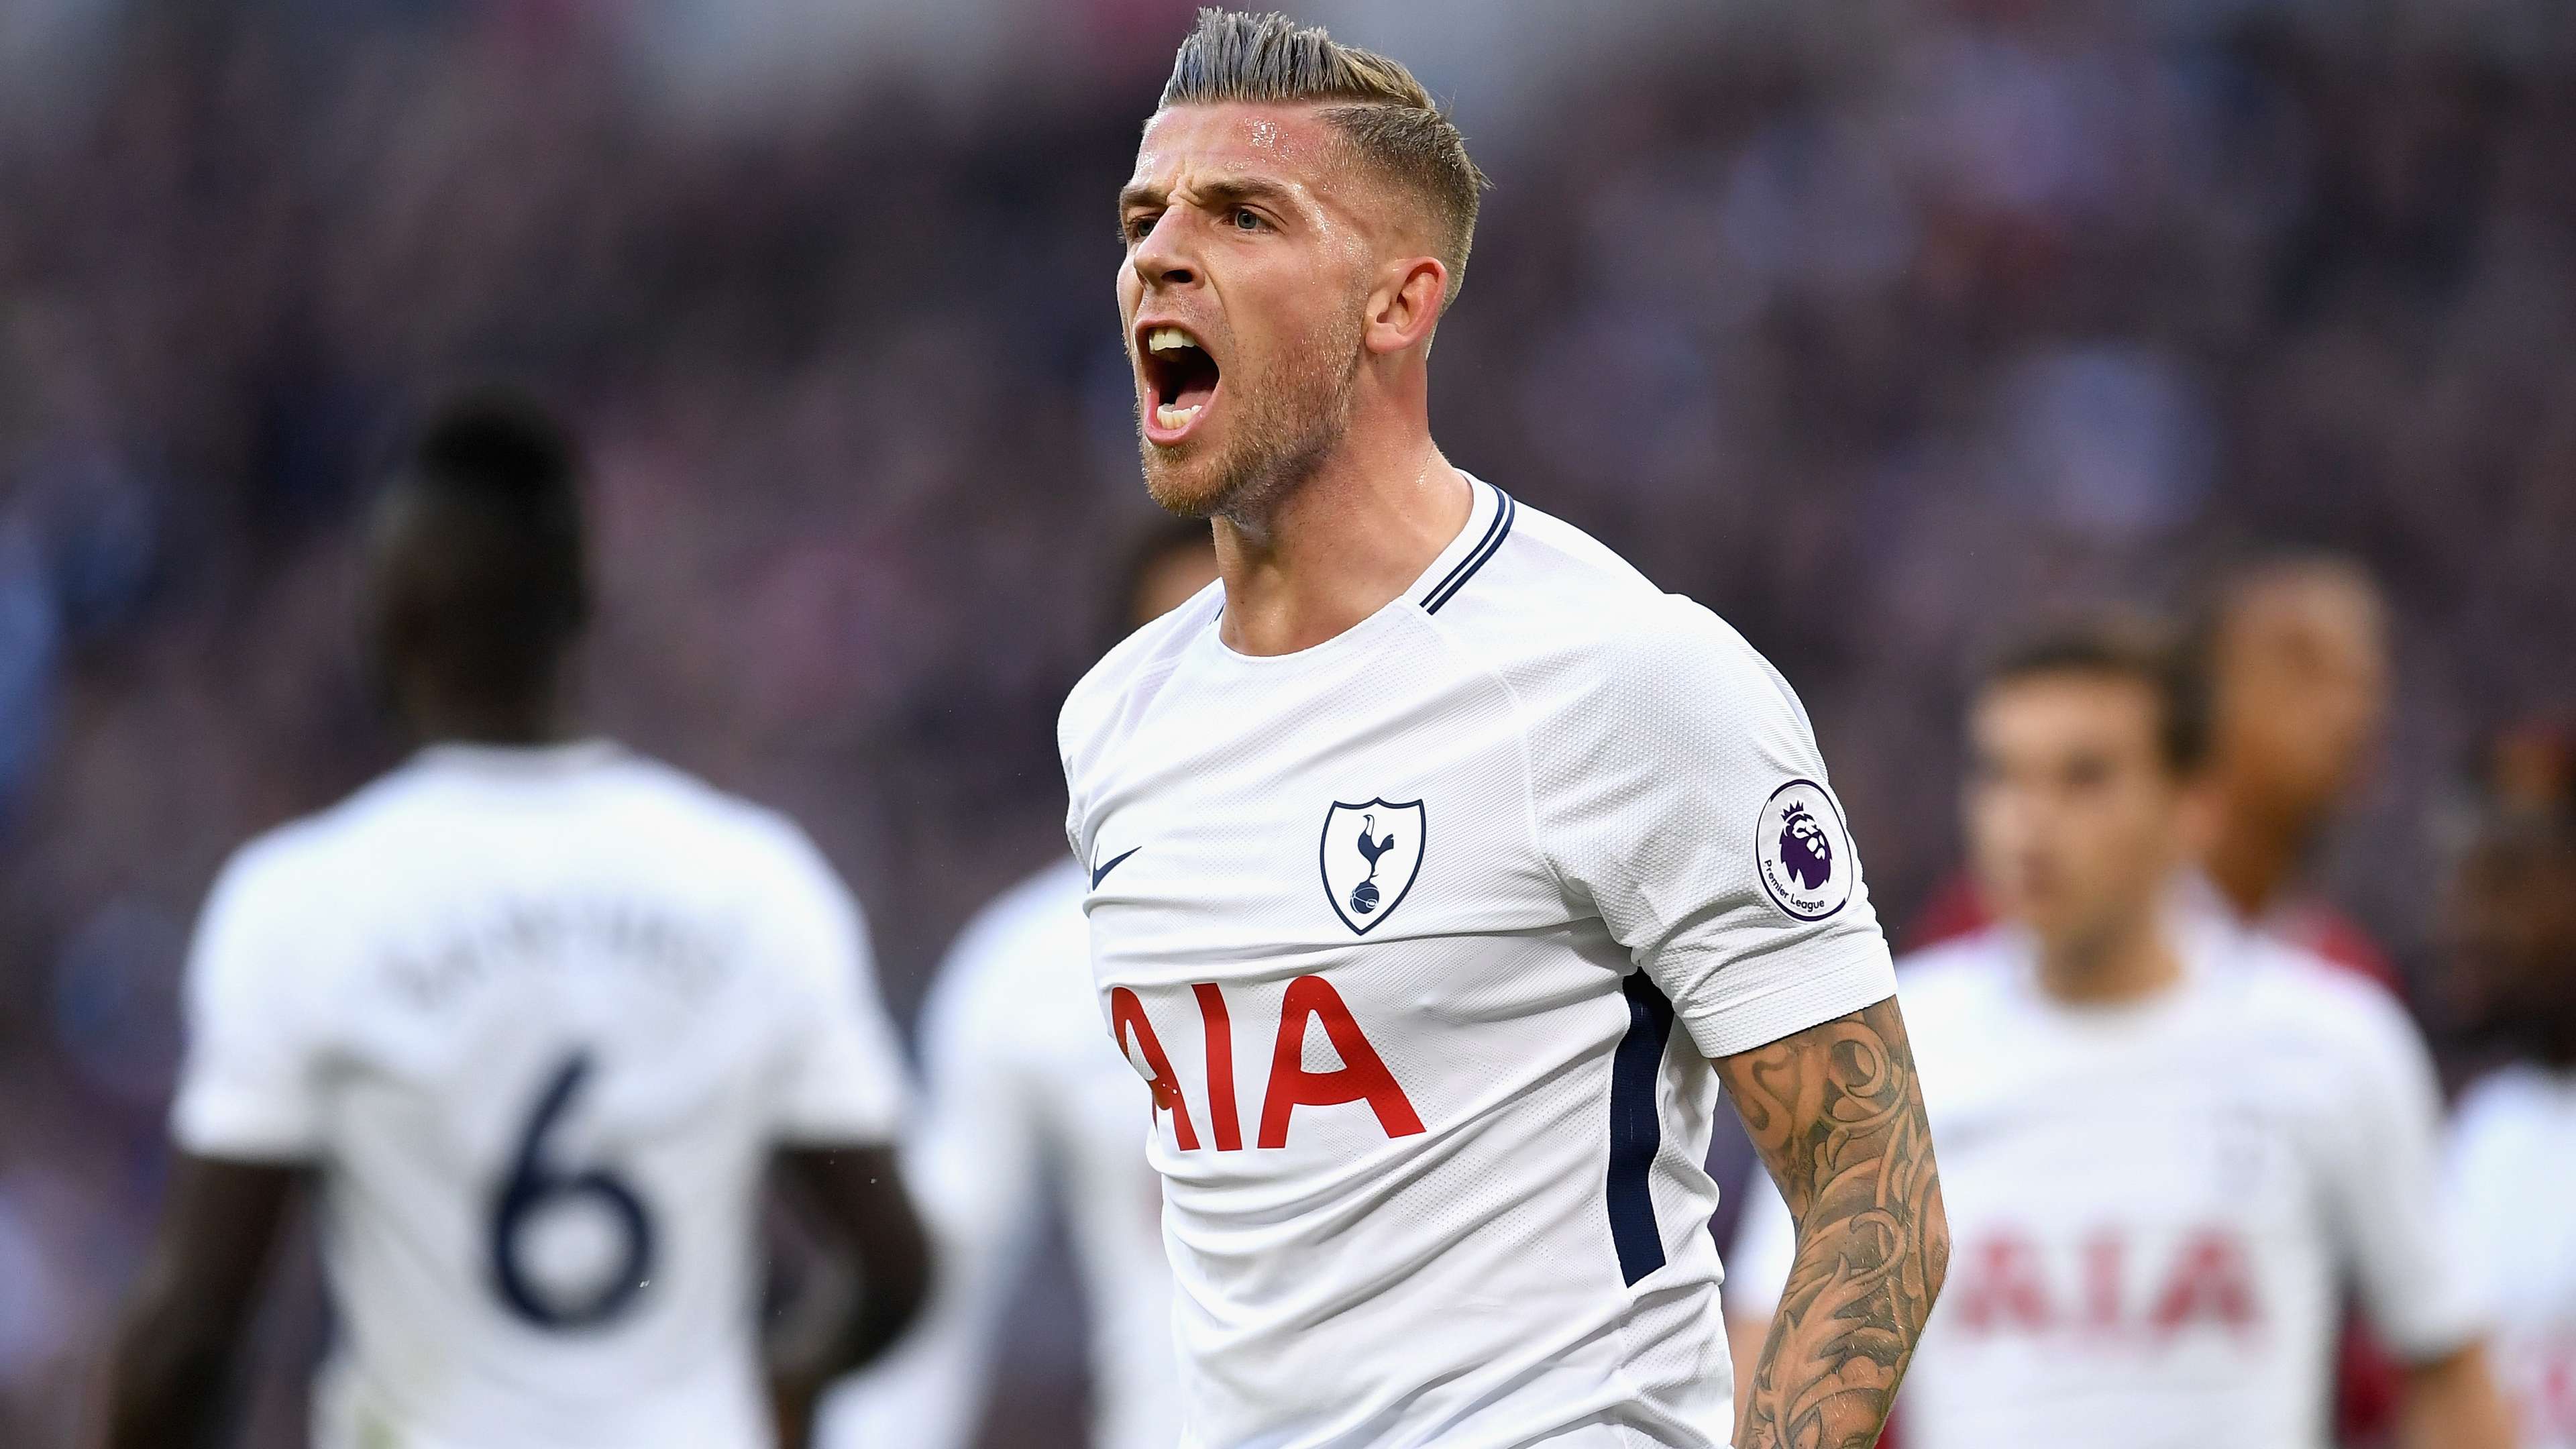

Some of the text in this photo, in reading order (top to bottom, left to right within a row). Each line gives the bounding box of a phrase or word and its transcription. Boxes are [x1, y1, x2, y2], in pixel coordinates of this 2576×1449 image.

[1764, 859, 1825, 912] Premier League
[1111, 975, 1427, 1151] AIA
[488, 1043, 661, 1335] 6
[1951, 1222, 2271, 1345] AIA
